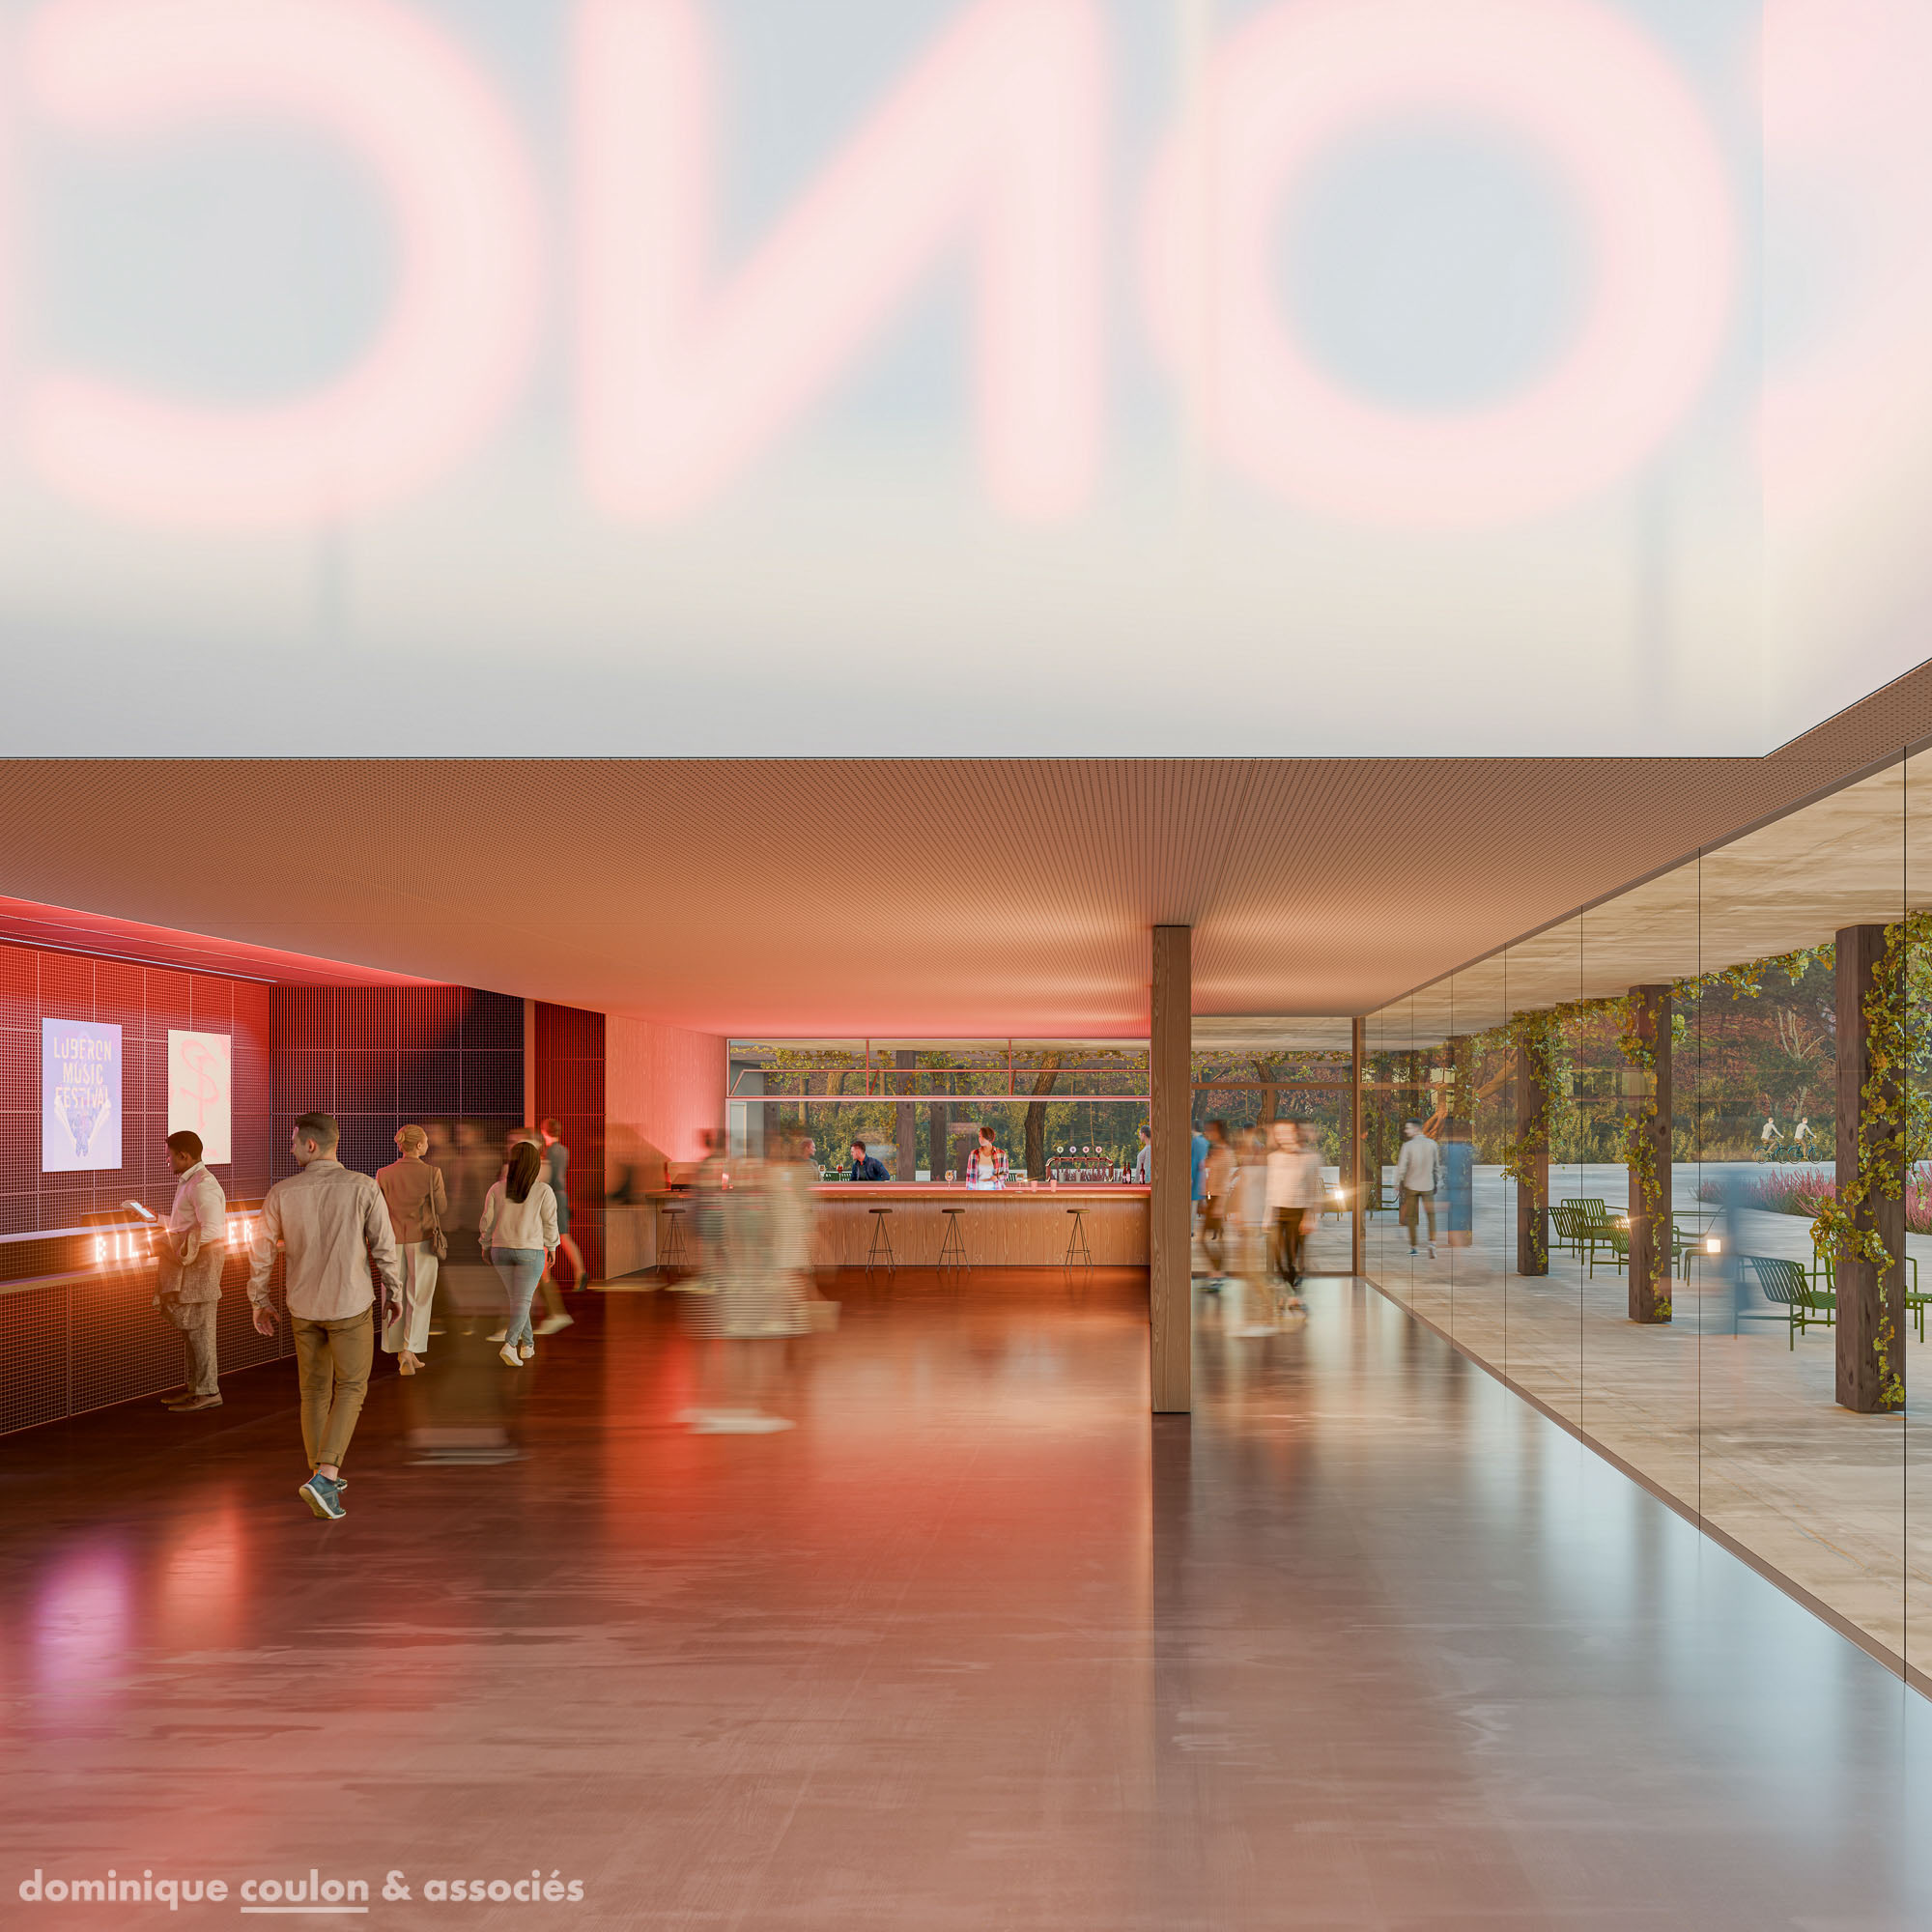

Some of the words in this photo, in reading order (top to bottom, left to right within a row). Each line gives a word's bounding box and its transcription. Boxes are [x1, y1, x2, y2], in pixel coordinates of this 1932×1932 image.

[53, 1037, 112, 1062] LUBERON
[63, 1063, 103, 1084] MUSIC
[55, 1086, 109, 1109] FESTIVAL
